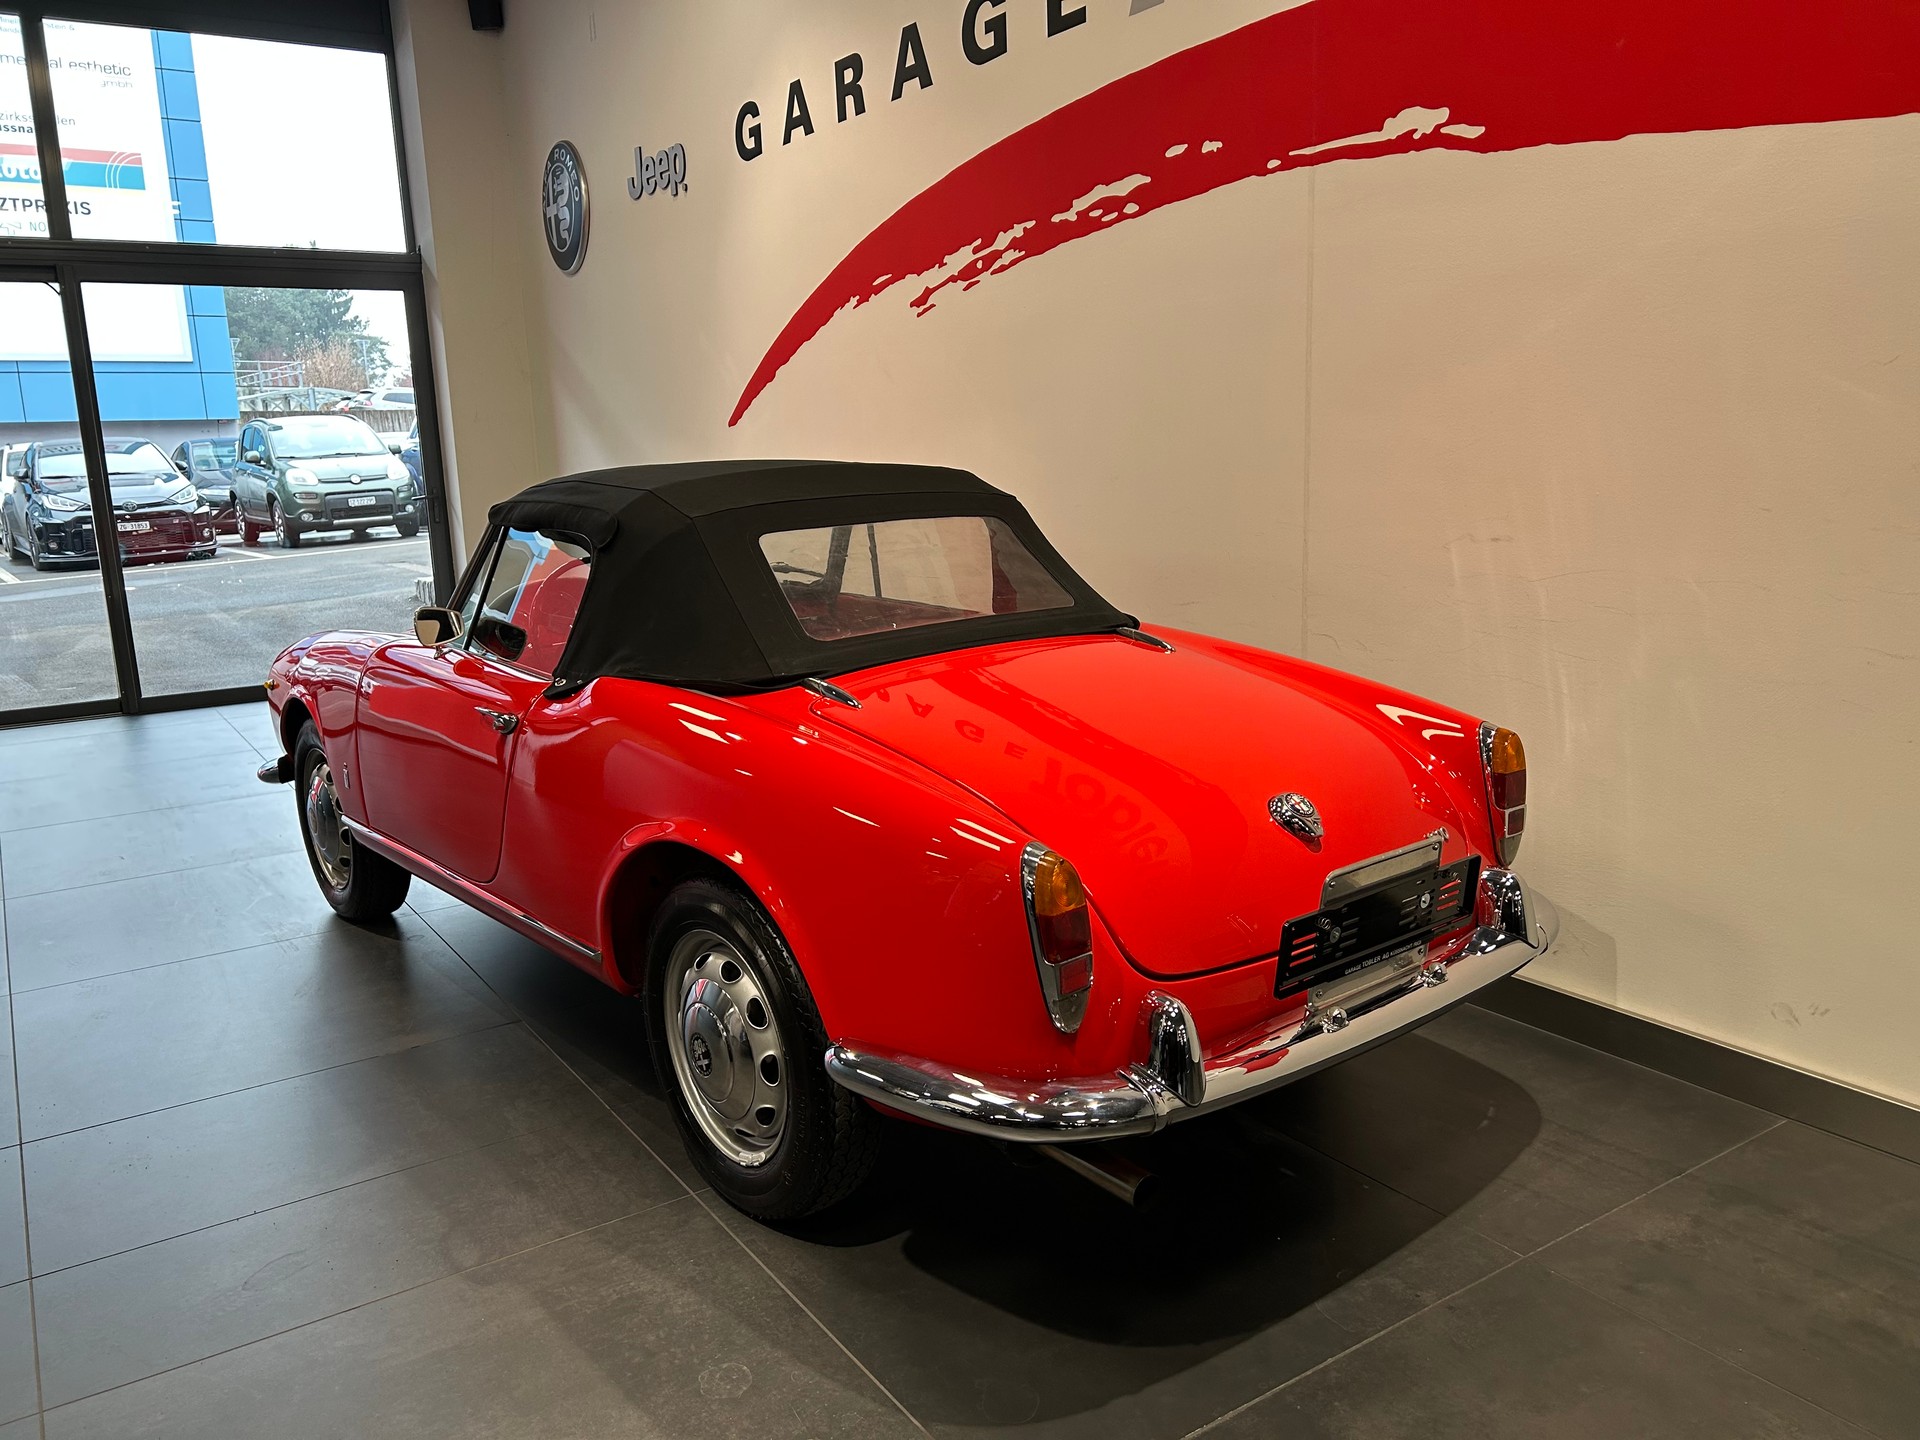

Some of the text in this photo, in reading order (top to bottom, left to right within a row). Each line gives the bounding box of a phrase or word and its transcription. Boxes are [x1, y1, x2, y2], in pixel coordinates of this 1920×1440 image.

[0, 54, 132, 77] meal esthetic
[553, 148, 581, 202] ROMEO
[627, 141, 688, 200] Jeep
[1344, 963, 1362, 975] GARAGE
[1362, 955, 1382, 968] TOBLER
[1382, 951, 1390, 960] AG
